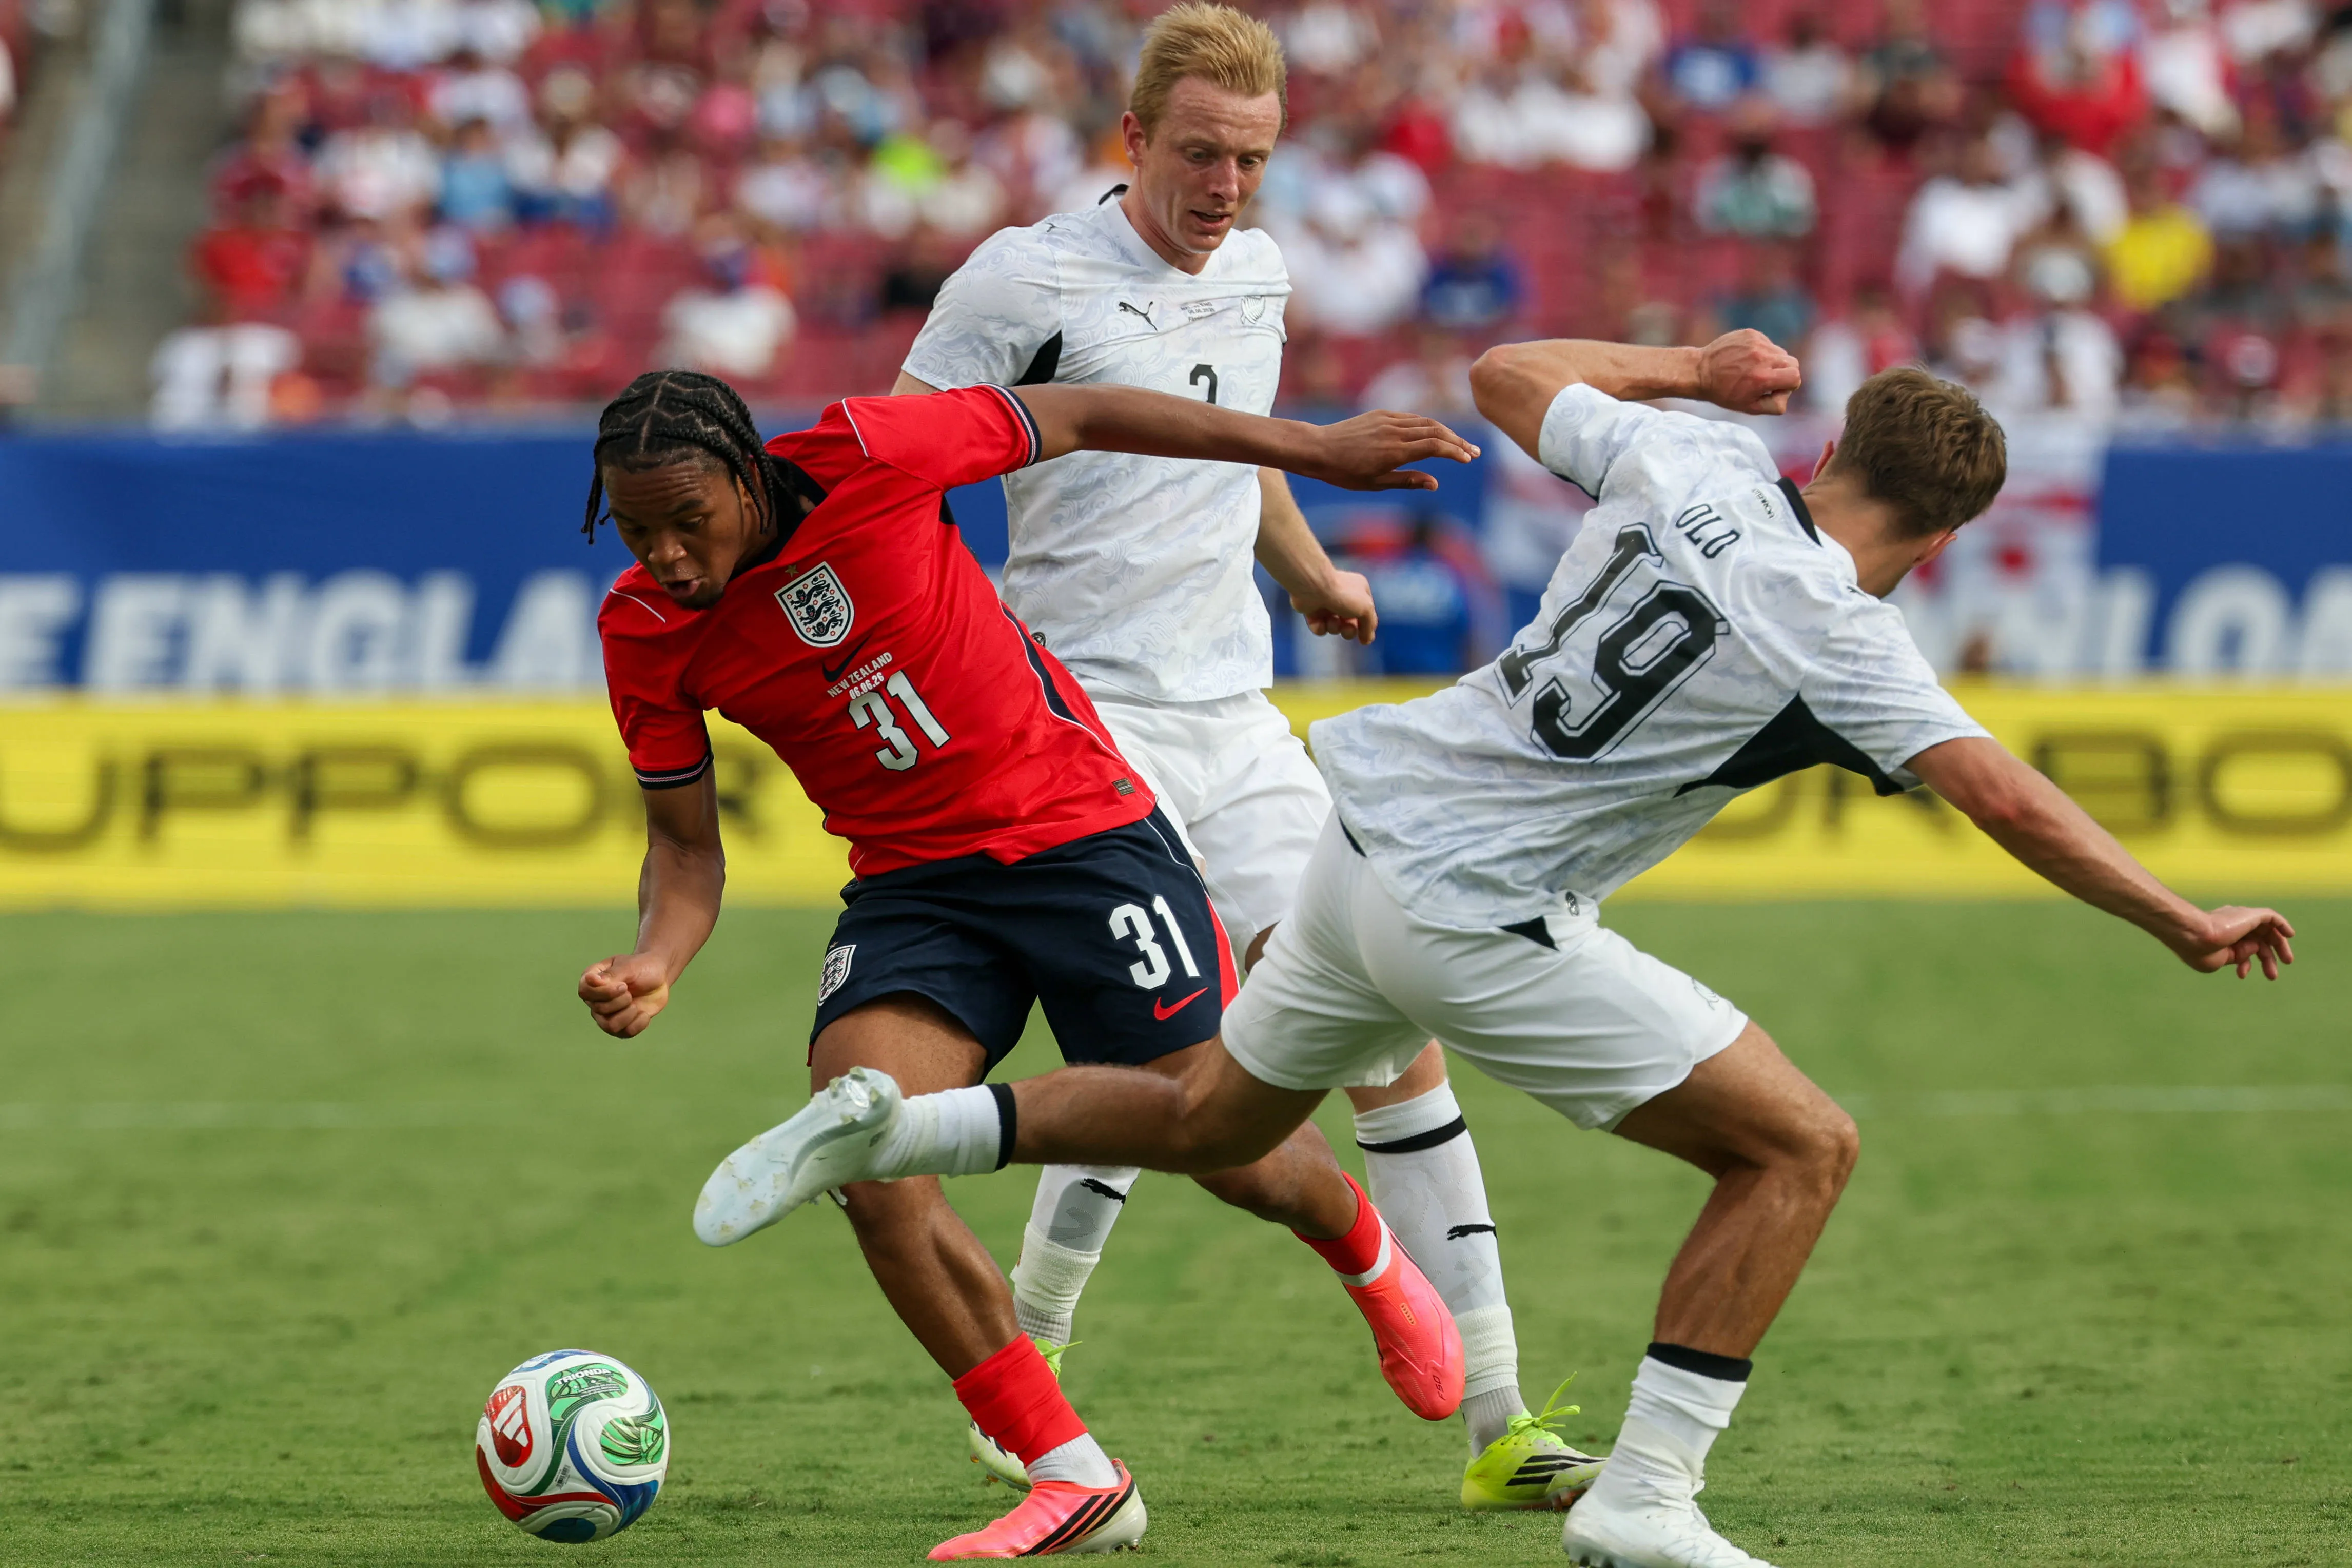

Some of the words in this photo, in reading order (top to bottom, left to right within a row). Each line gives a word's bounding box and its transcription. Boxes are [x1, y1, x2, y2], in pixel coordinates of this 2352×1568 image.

[1675, 503, 1741, 559] OLD
[83, 566, 611, 692] ENGLA
[1494, 522, 1730, 763] 19
[827, 678, 850, 698] NEW
[847, 652, 893, 684] ZEALAND
[849, 672, 885, 700] 06.06.26
[848, 669, 951, 771] 31
[1108, 894, 1202, 991] 31
[554, 1368, 612, 1385] TRIONDA
[1432, 1375, 1446, 1401] F50
